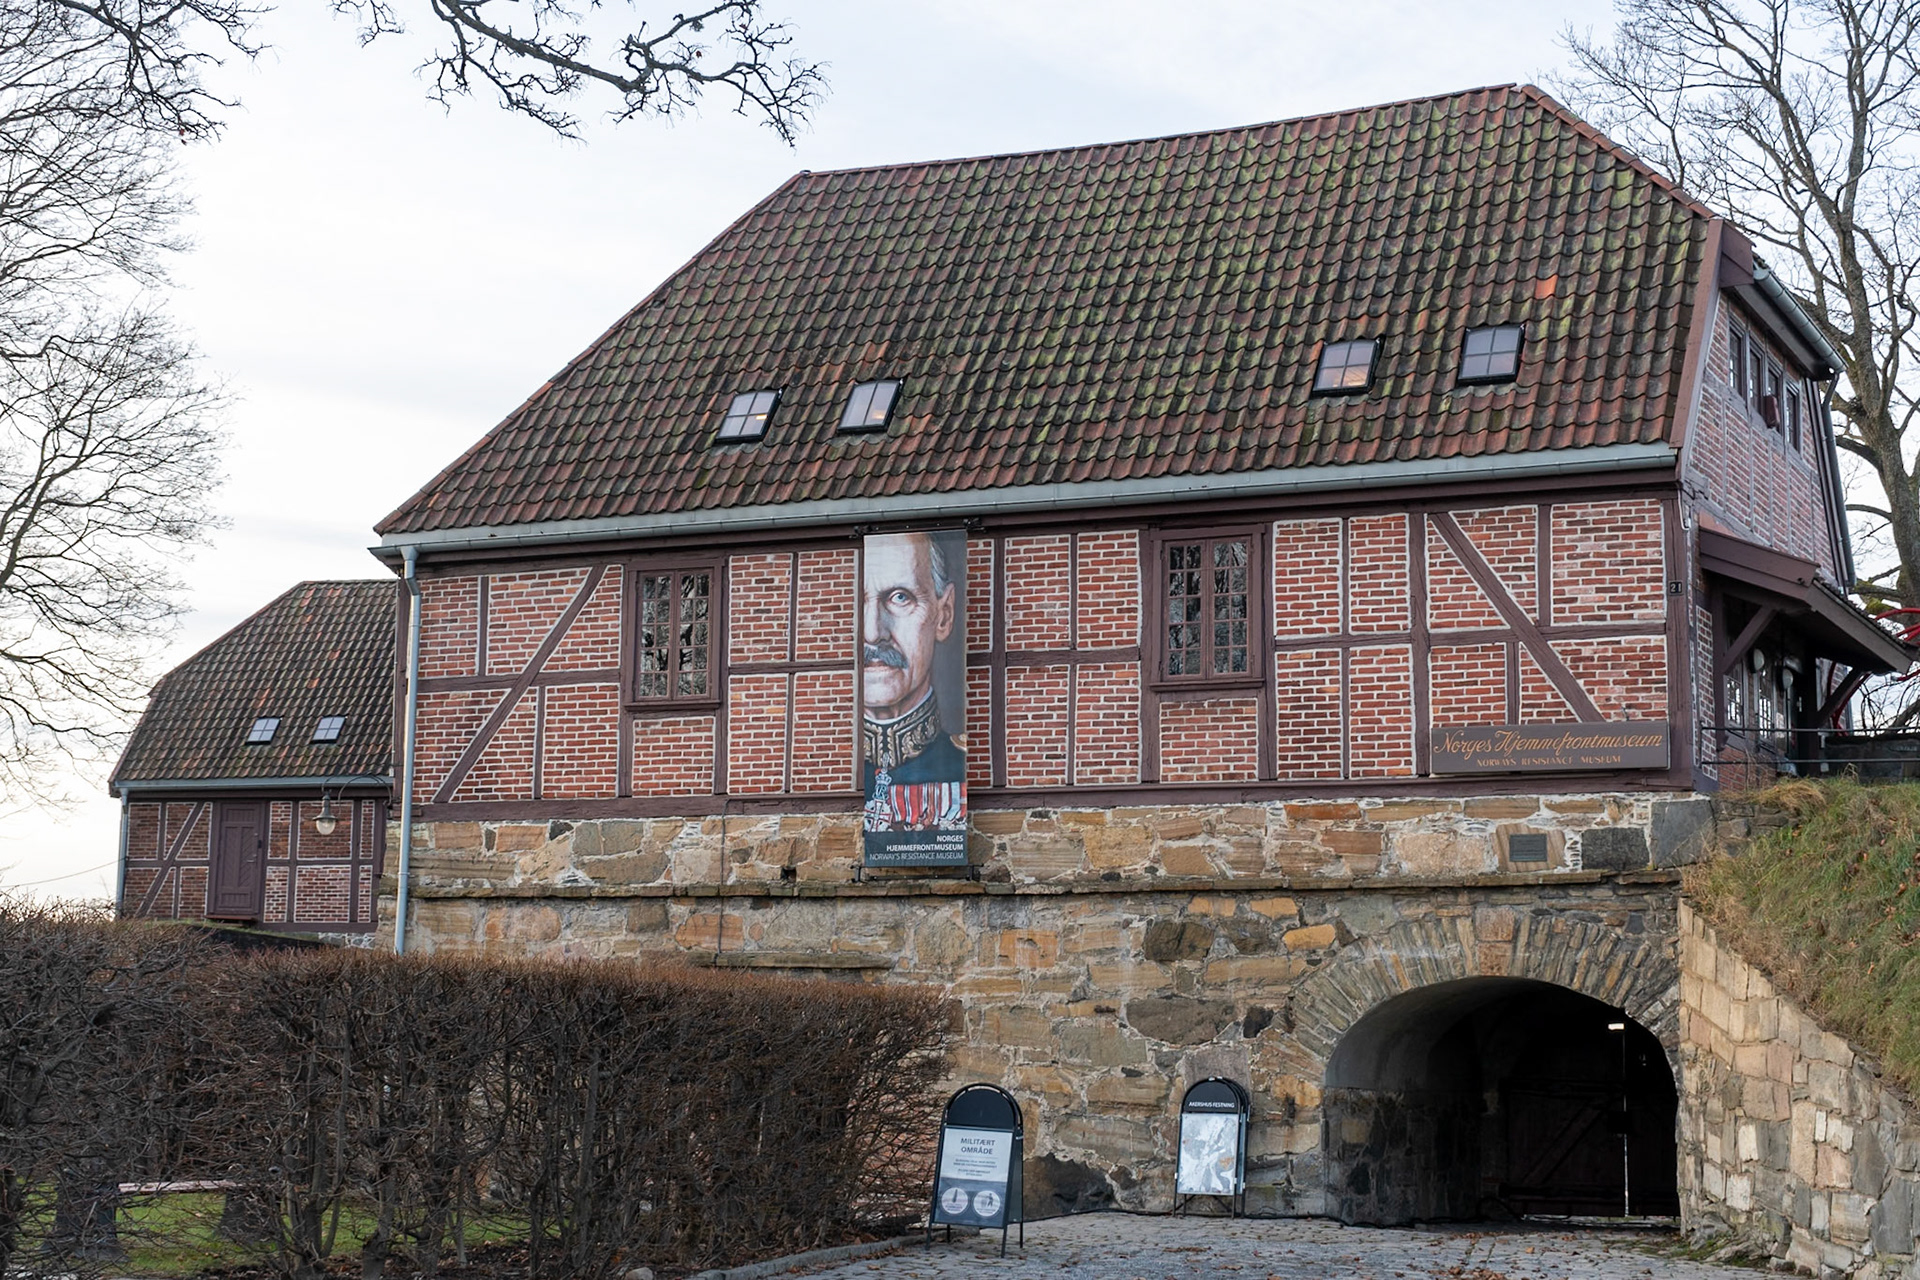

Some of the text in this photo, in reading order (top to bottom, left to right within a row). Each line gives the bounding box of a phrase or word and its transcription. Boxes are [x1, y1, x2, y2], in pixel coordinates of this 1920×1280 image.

[1670, 583, 1682, 592] 21
[1433, 729, 1663, 761] Norges Hjemmefrontmuseum
[1521, 756, 1574, 766] RESISTANCE
[1581, 755, 1621, 764] MUSEUM
[960, 1137, 996, 1146] MILITÆRT
[960, 1146, 993, 1155] OMRÅDE
